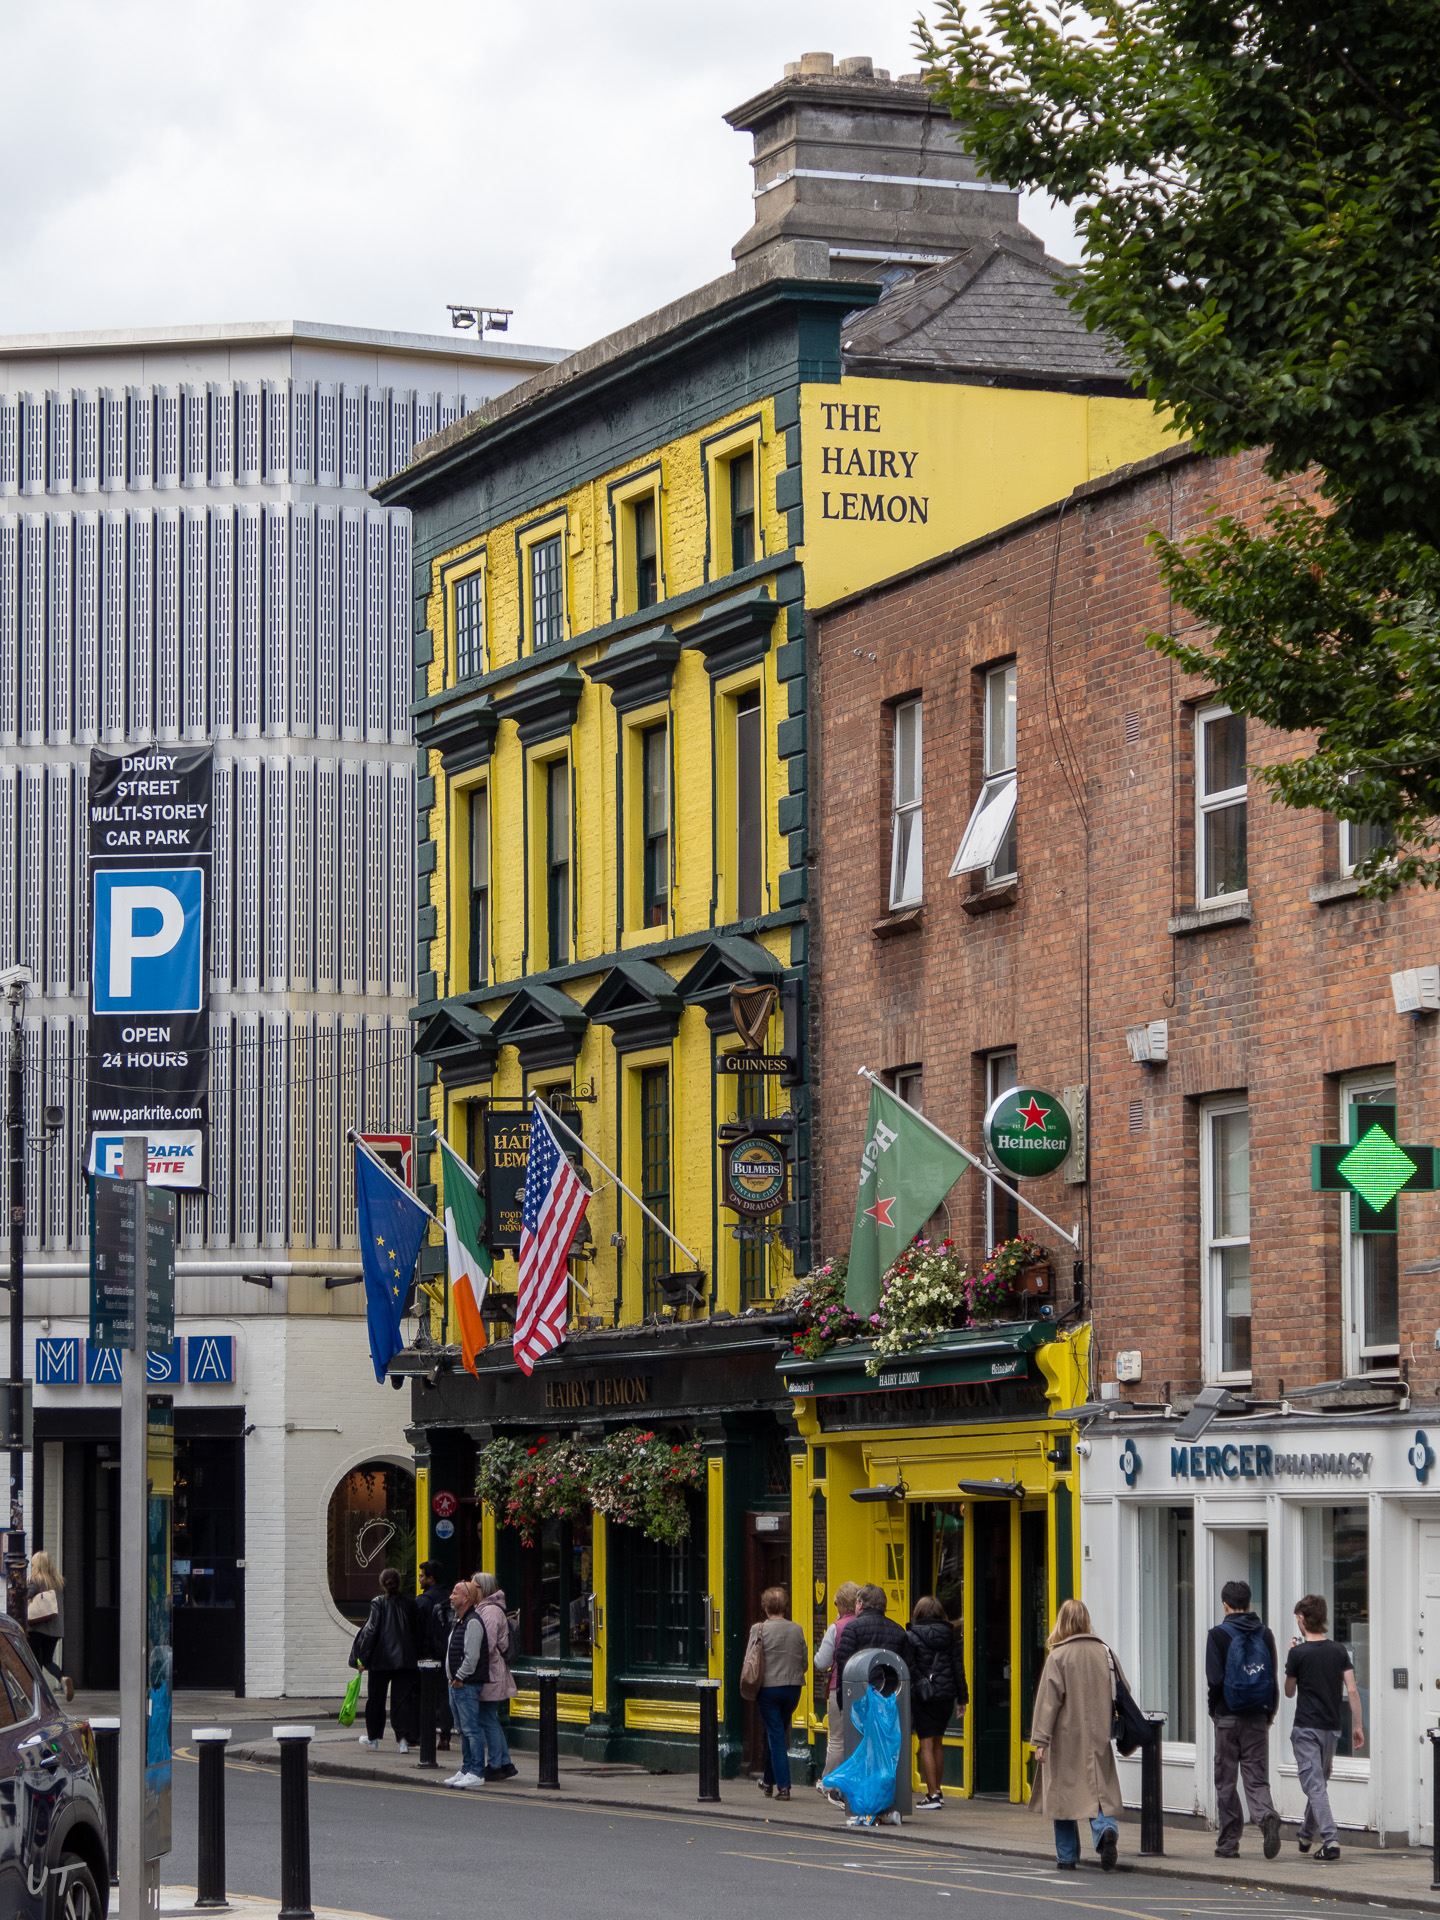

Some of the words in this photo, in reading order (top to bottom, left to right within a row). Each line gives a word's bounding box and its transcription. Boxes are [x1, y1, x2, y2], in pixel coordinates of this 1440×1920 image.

[820, 401, 881, 433] THE
[821, 446, 919, 478] HAIRY
[822, 491, 930, 525] LEMON
[121, 756, 178, 772] DRURY
[117, 780, 180, 796] STREET
[91, 804, 208, 822] MULTI-STOREY
[106, 831, 141, 846] CAR
[145, 829, 190, 845] PARK
[109, 886, 184, 997] P
[122, 1027, 170, 1043] OPEN
[102, 1052, 122, 1068] 24
[127, 1051, 188, 1067] HOURS
[726, 1056, 788, 1071] GUINNESS
[92, 1105, 202, 1124] www.parkrite.com
[518, 1123, 532, 1132] TH
[494, 1134, 531, 1149] HAI
[997, 1135, 1066, 1150] Heineken
[494, 1152, 530, 1167] LEM
[858, 1119, 899, 1186] Hein
[734, 1162, 780, 1175] BULMERS
[734, 1181, 760, 1199] VINTAGE
[762, 1181, 780, 1197] CIDER
[729, 1193, 743, 1206] ON
[743, 1192, 784, 1211] DRAUGHT
[879, 1374, 898, 1387] HAIRY
[898, 1371, 920, 1385] LEMON
[545, 1380, 588, 1408] HAIRY
[595, 1376, 647, 1406] LEMON
[1171, 1443, 1273, 1478] MERCER
[1274, 1452, 1372, 1476] PHARMACY
